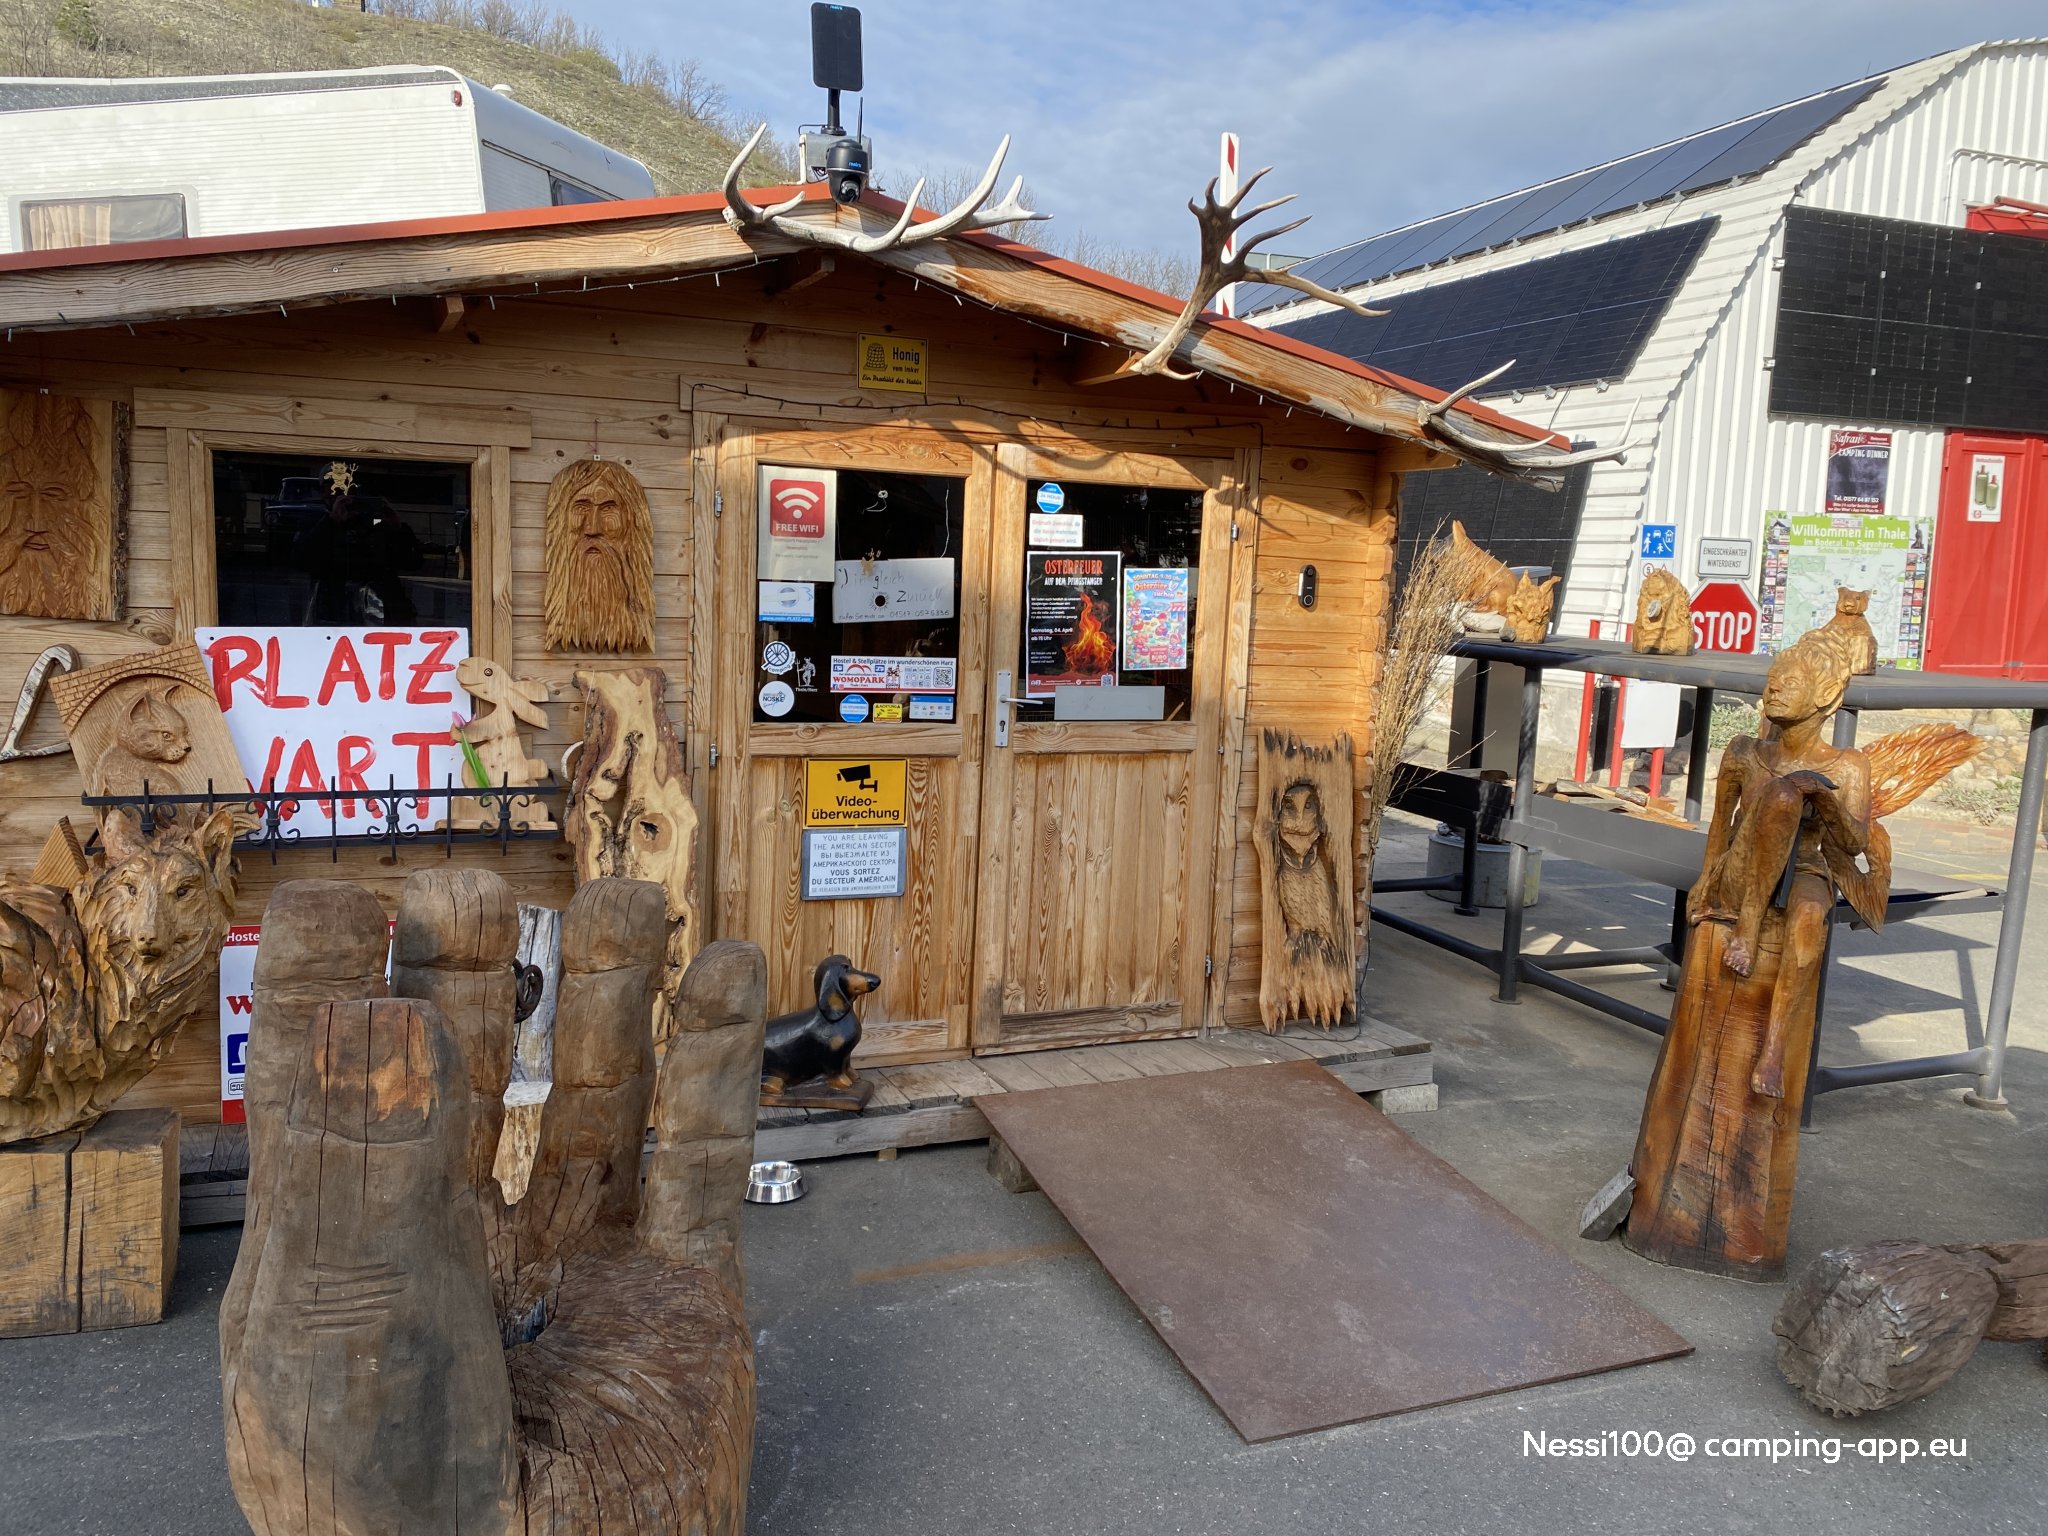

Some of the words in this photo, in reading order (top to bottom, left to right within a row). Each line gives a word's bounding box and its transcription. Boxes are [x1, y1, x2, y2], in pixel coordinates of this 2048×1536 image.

[893, 347, 920, 365] Honig
[1834, 432, 1861, 446] Safran
[1839, 449, 1866, 458] CAMPING
[1867, 450, 1889, 459] DINNER
[776, 523, 798, 532] FREE
[800, 525, 819, 533] WIFI
[1792, 524, 1861, 538] Willkommen
[1864, 527, 1875, 538] in
[1877, 527, 1909, 539] Thale.
[1703, 547, 1747, 557] EINGESCHRÄNKTER
[1044, 559, 1103, 575] OSTERFEUER
[1708, 560, 1742, 568] WINTERDIENST
[1044, 577, 1053, 585] AUF
[1055, 577, 1066, 585] DEM
[1691, 611, 1752, 650] STOP
[836, 796, 878, 807] Video-
[811, 808, 900, 821] überwachung
[830, 842, 868, 850] AMERICAN
[870, 841, 897, 849] SECTOR
[835, 850, 878, 858] ВЫЕЗЖАЕТЕ
[853, 867, 880, 875] SORTEZ
[858, 875, 896, 884] AMÉRICAIN
[226, 932, 260, 942] Hoste
